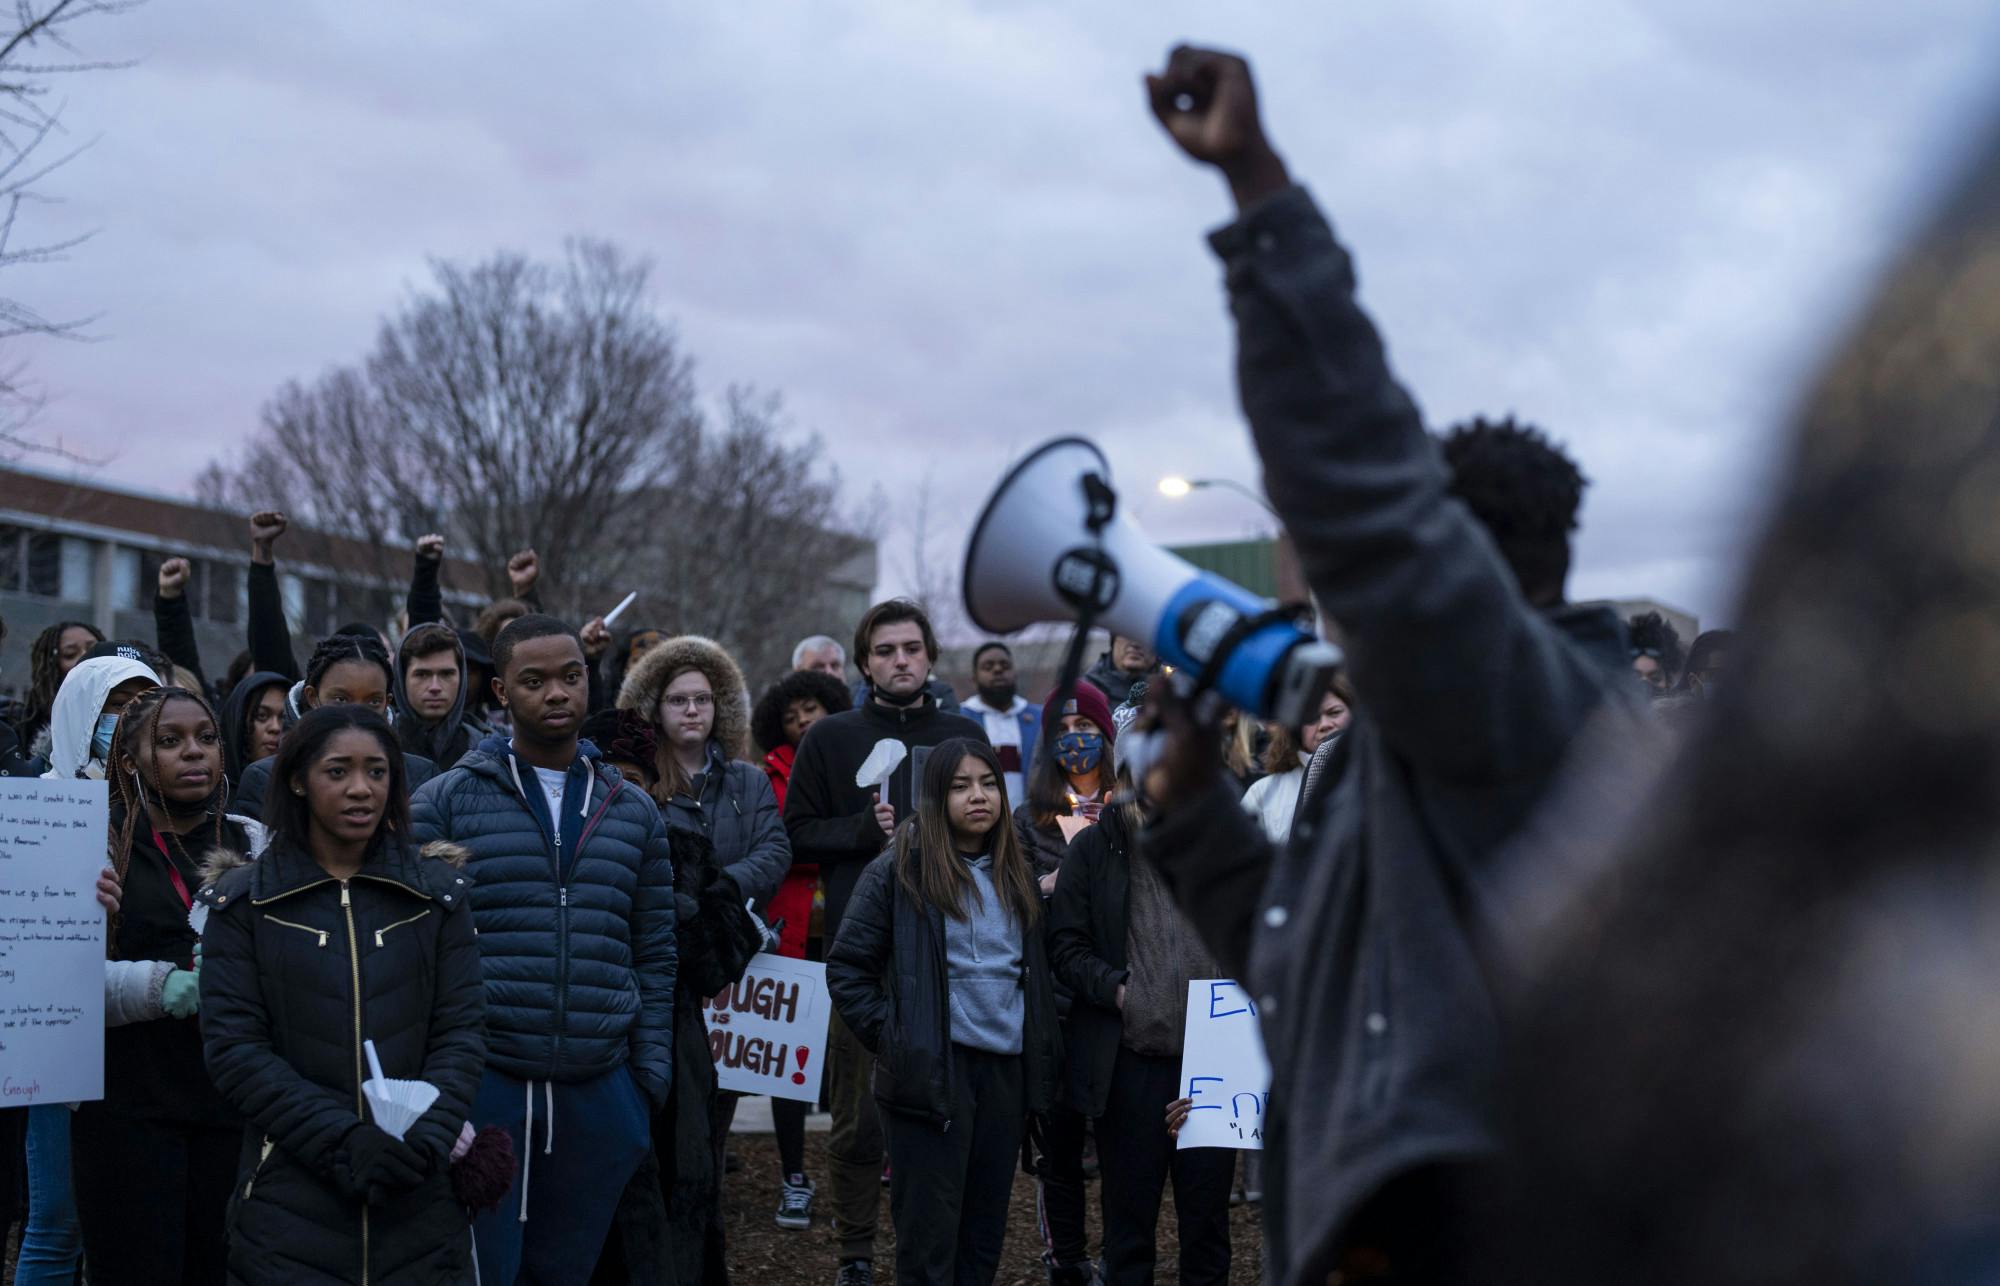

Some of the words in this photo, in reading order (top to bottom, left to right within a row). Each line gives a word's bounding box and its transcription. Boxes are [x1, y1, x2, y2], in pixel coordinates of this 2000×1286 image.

[8, 793, 22, 801] was
[15, 889, 27, 897] we
[31, 890, 39, 902] go
[44, 884, 59, 897] from
[3, 1076, 40, 1101] Enough
